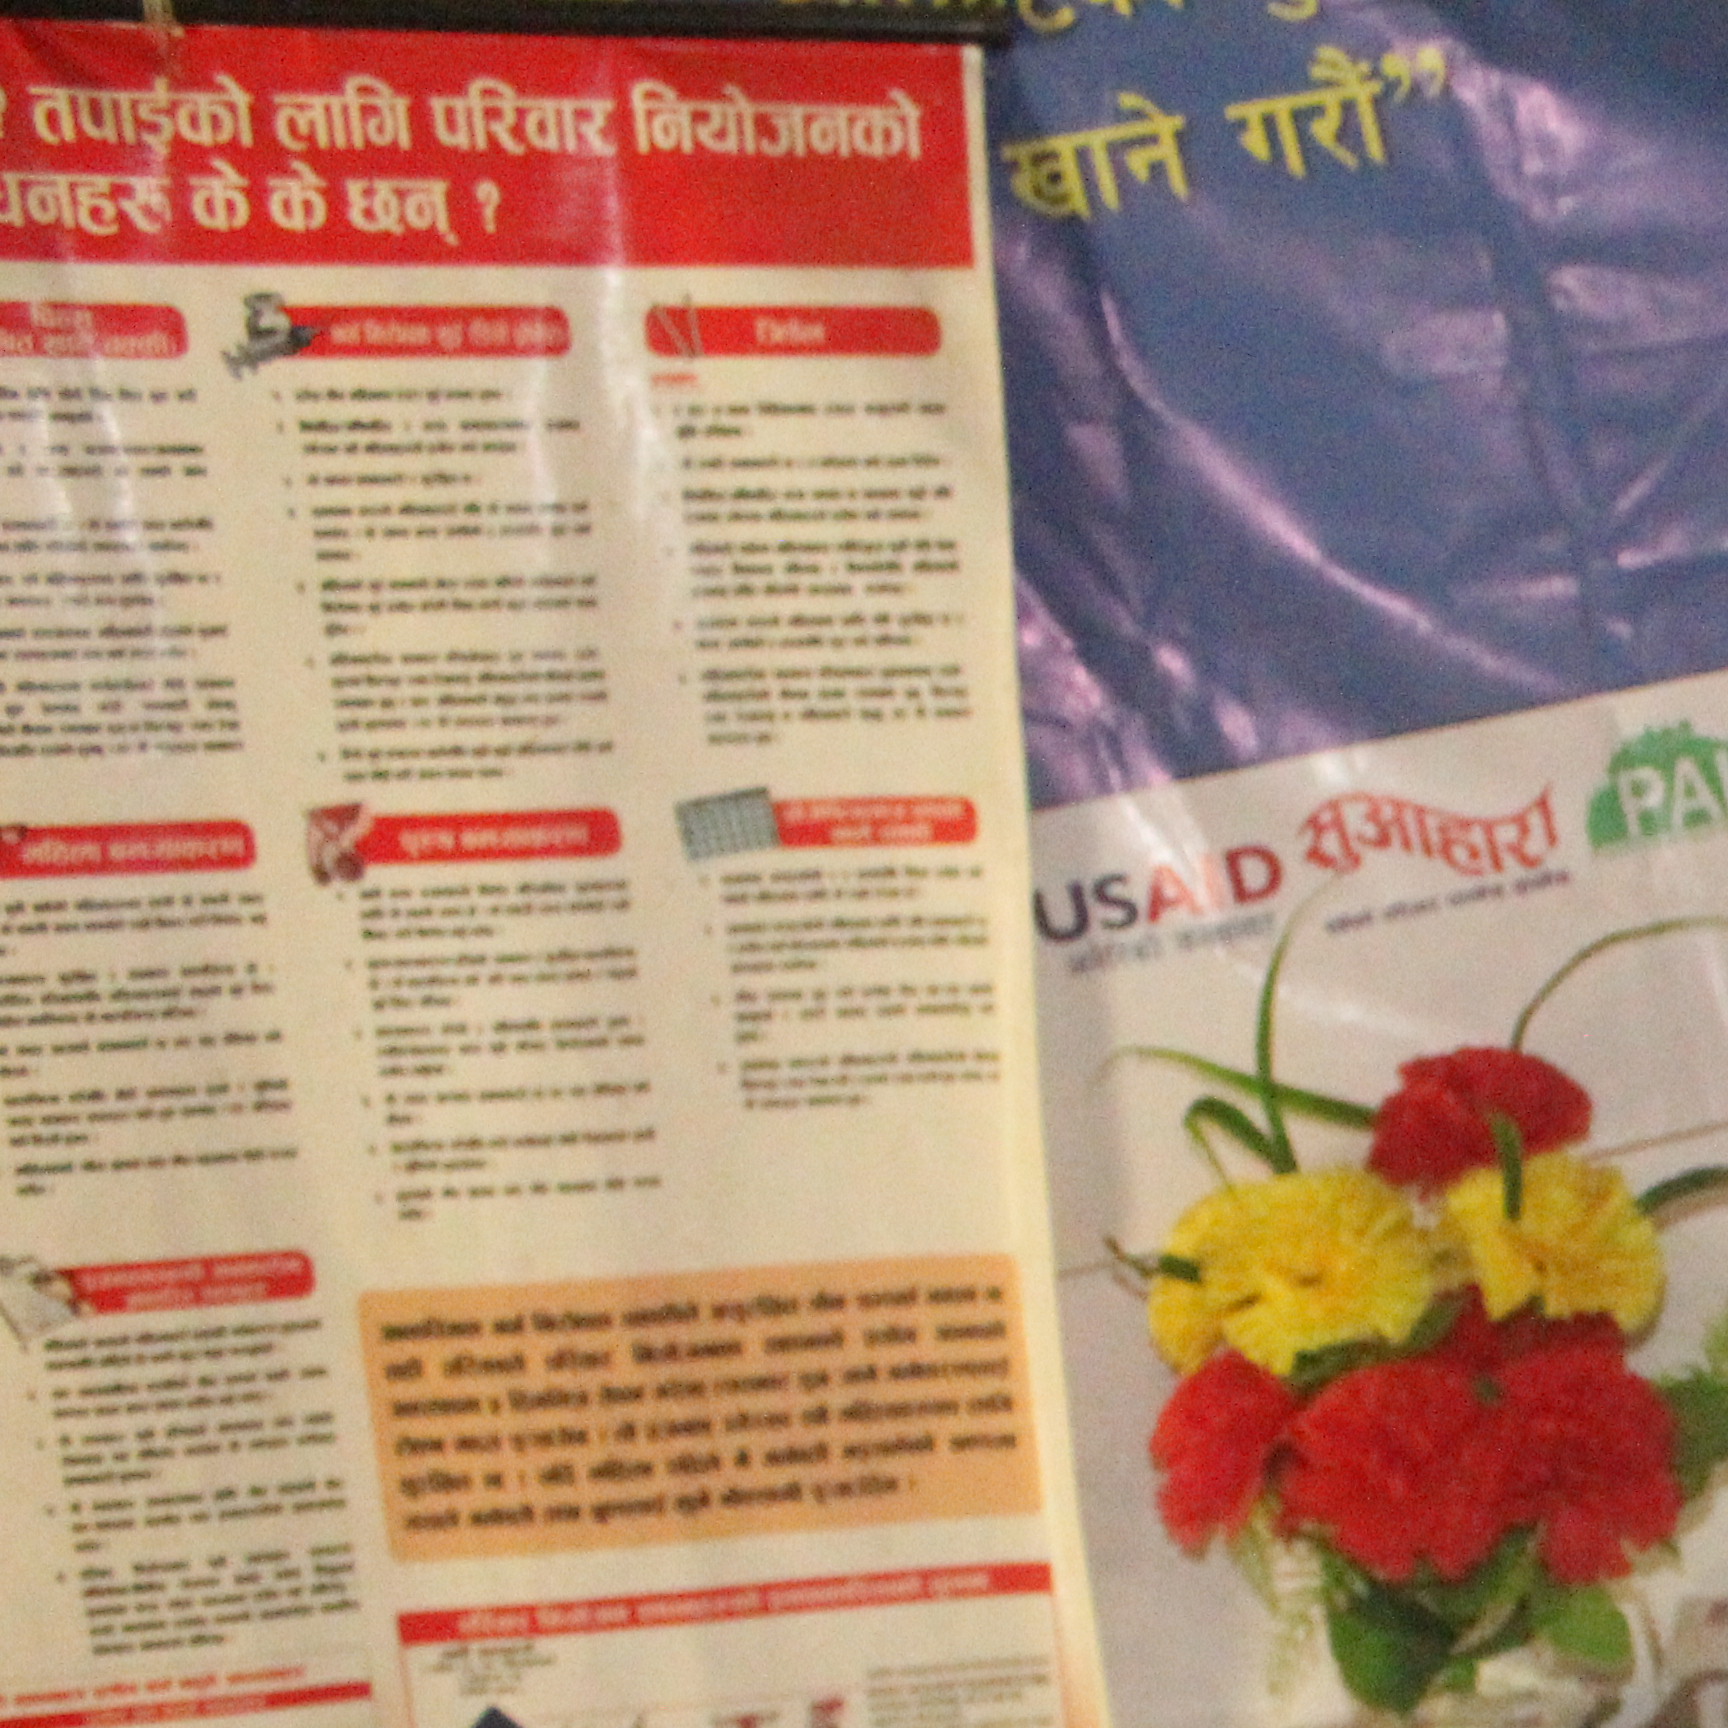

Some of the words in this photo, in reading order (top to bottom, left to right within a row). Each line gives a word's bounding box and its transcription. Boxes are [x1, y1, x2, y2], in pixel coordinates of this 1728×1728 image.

[273, 74, 411, 151] लागि
[430, 78, 617, 156] परिवार
[630, 80, 922, 160] नियोजनको
[1002, 91, 1190, 221] खाने
[188, 157, 250, 232] के
[267, 159, 328, 232] के
[1034, 844, 1282, 944] USAID
